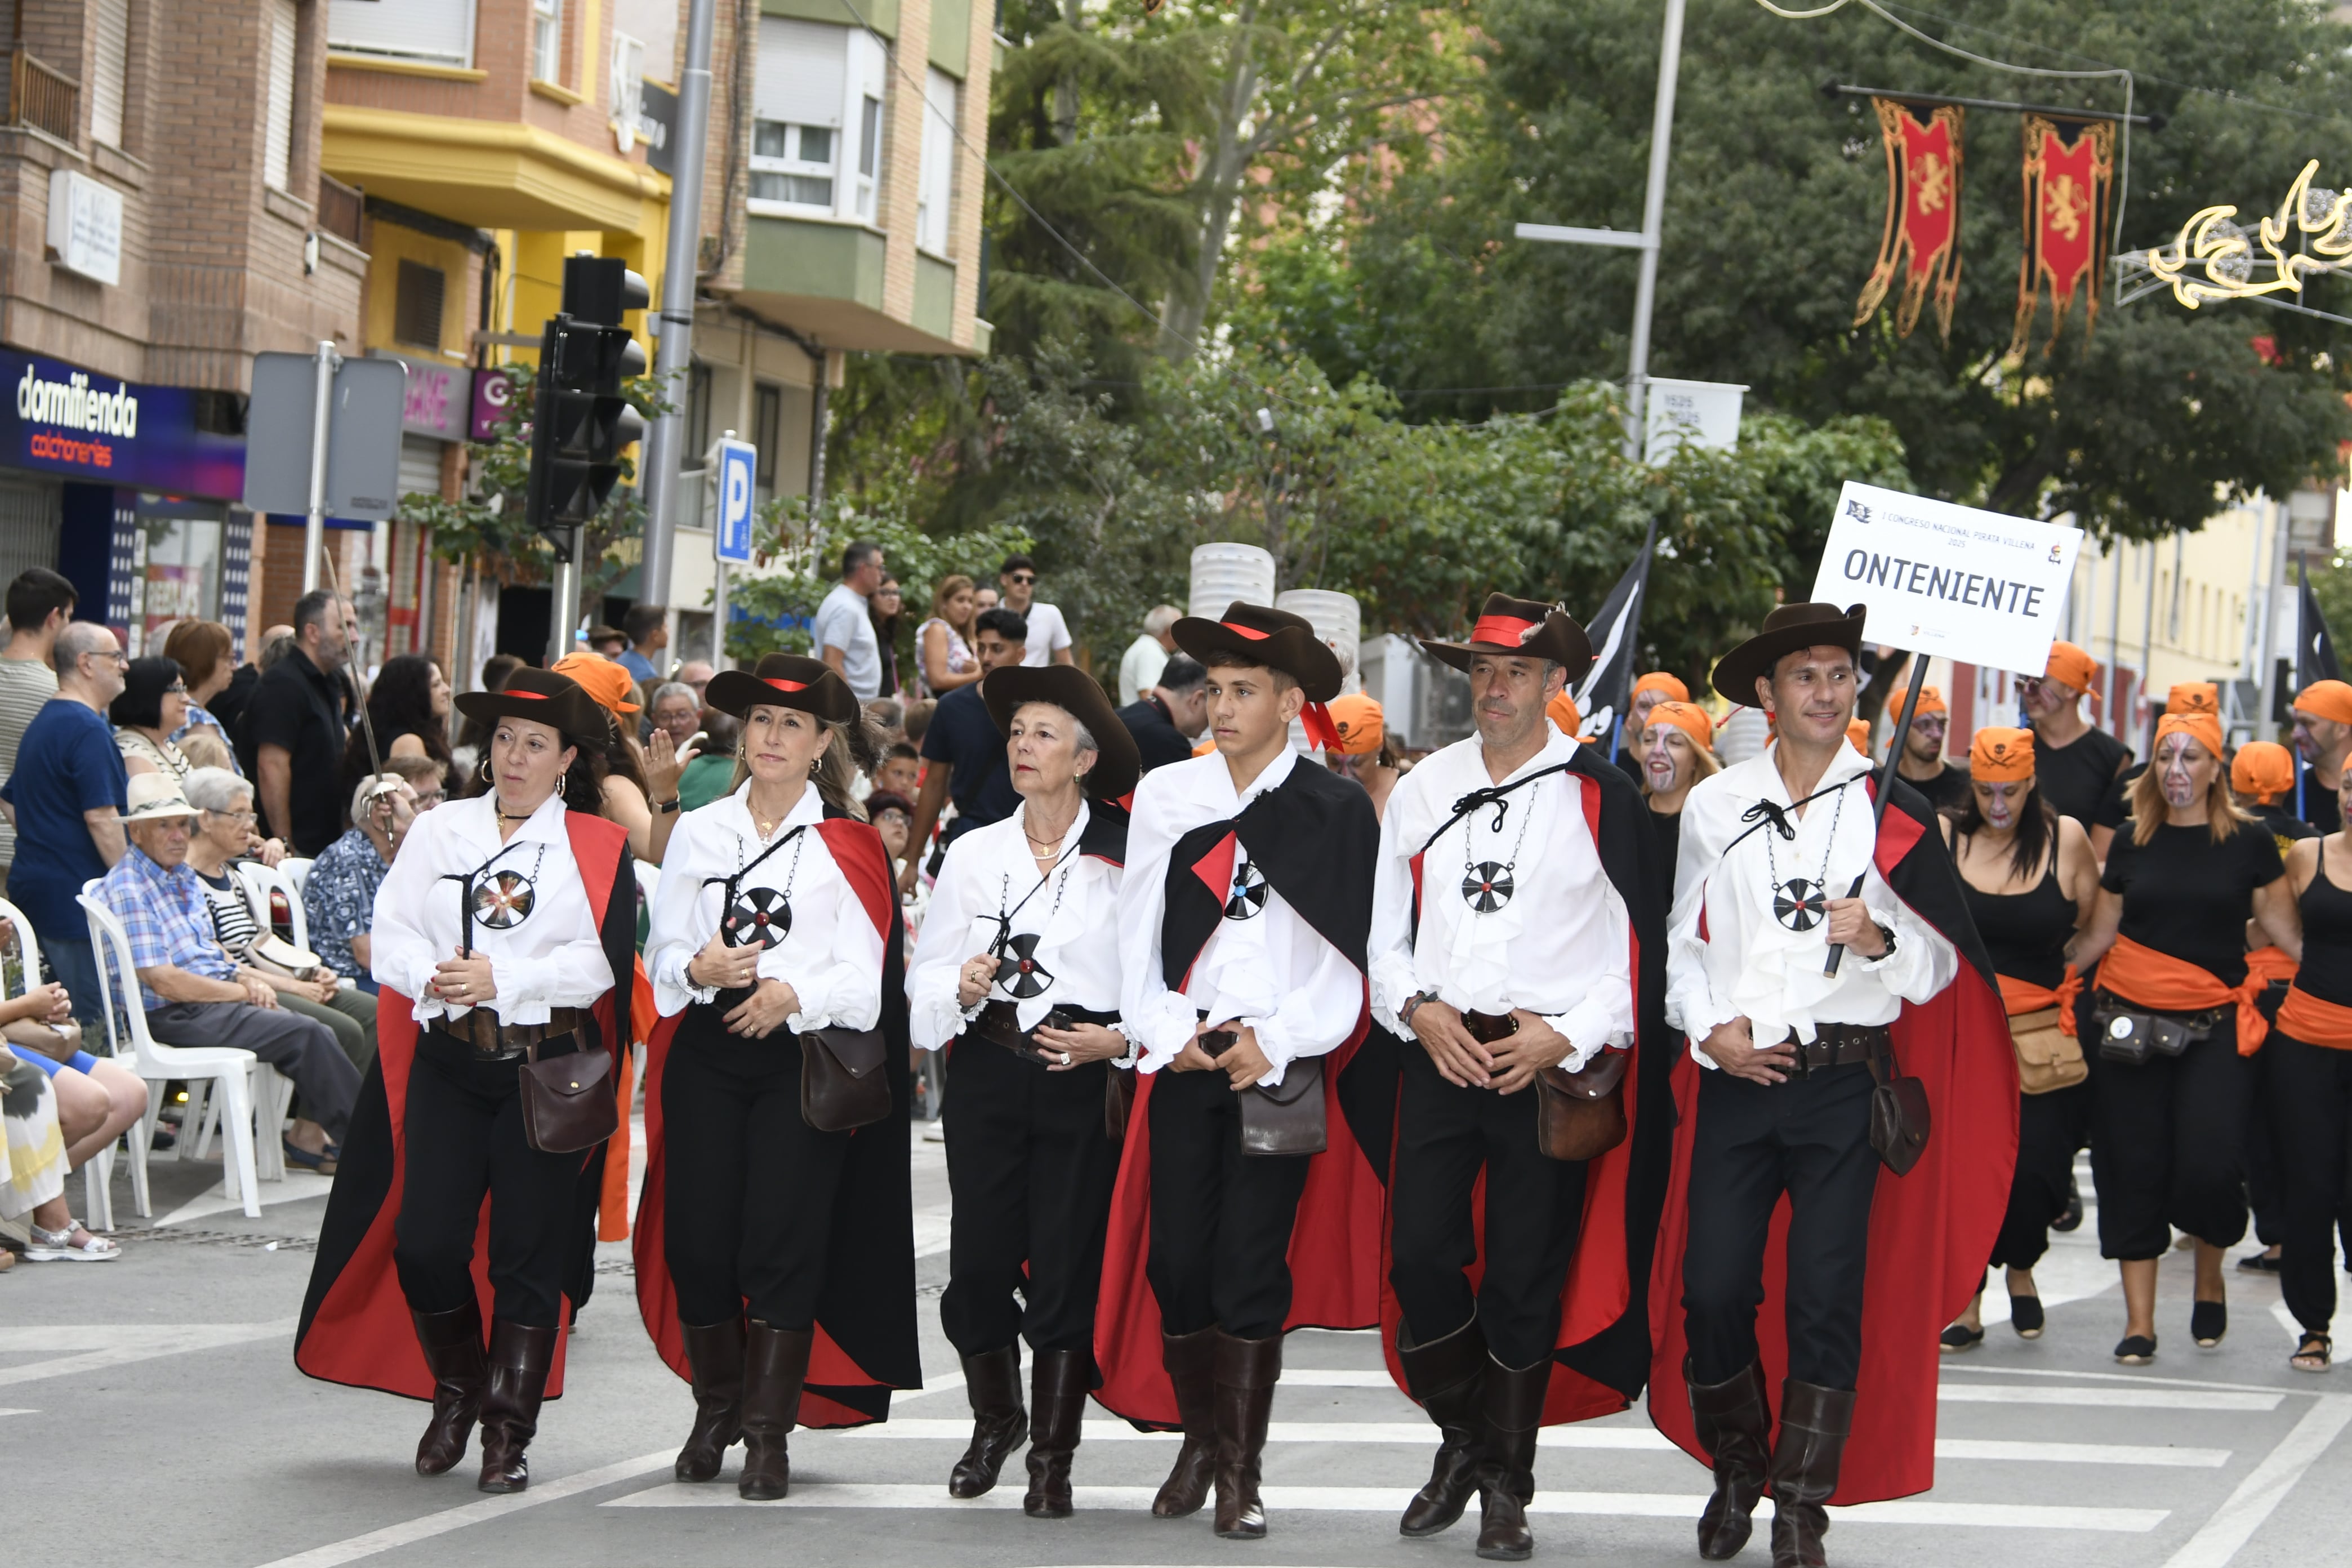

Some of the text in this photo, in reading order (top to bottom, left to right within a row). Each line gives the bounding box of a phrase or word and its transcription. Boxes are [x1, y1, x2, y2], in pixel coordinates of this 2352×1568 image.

[17, 363, 138, 439] dormitienda
[724, 458, 749, 549] P
[1882, 511, 2035, 550] I CONGRESO NACIONAL PIRATA VILLENA
[1948, 537, 1966, 548] 2025
[1845, 549, 2044, 617] ONTENIENTE
